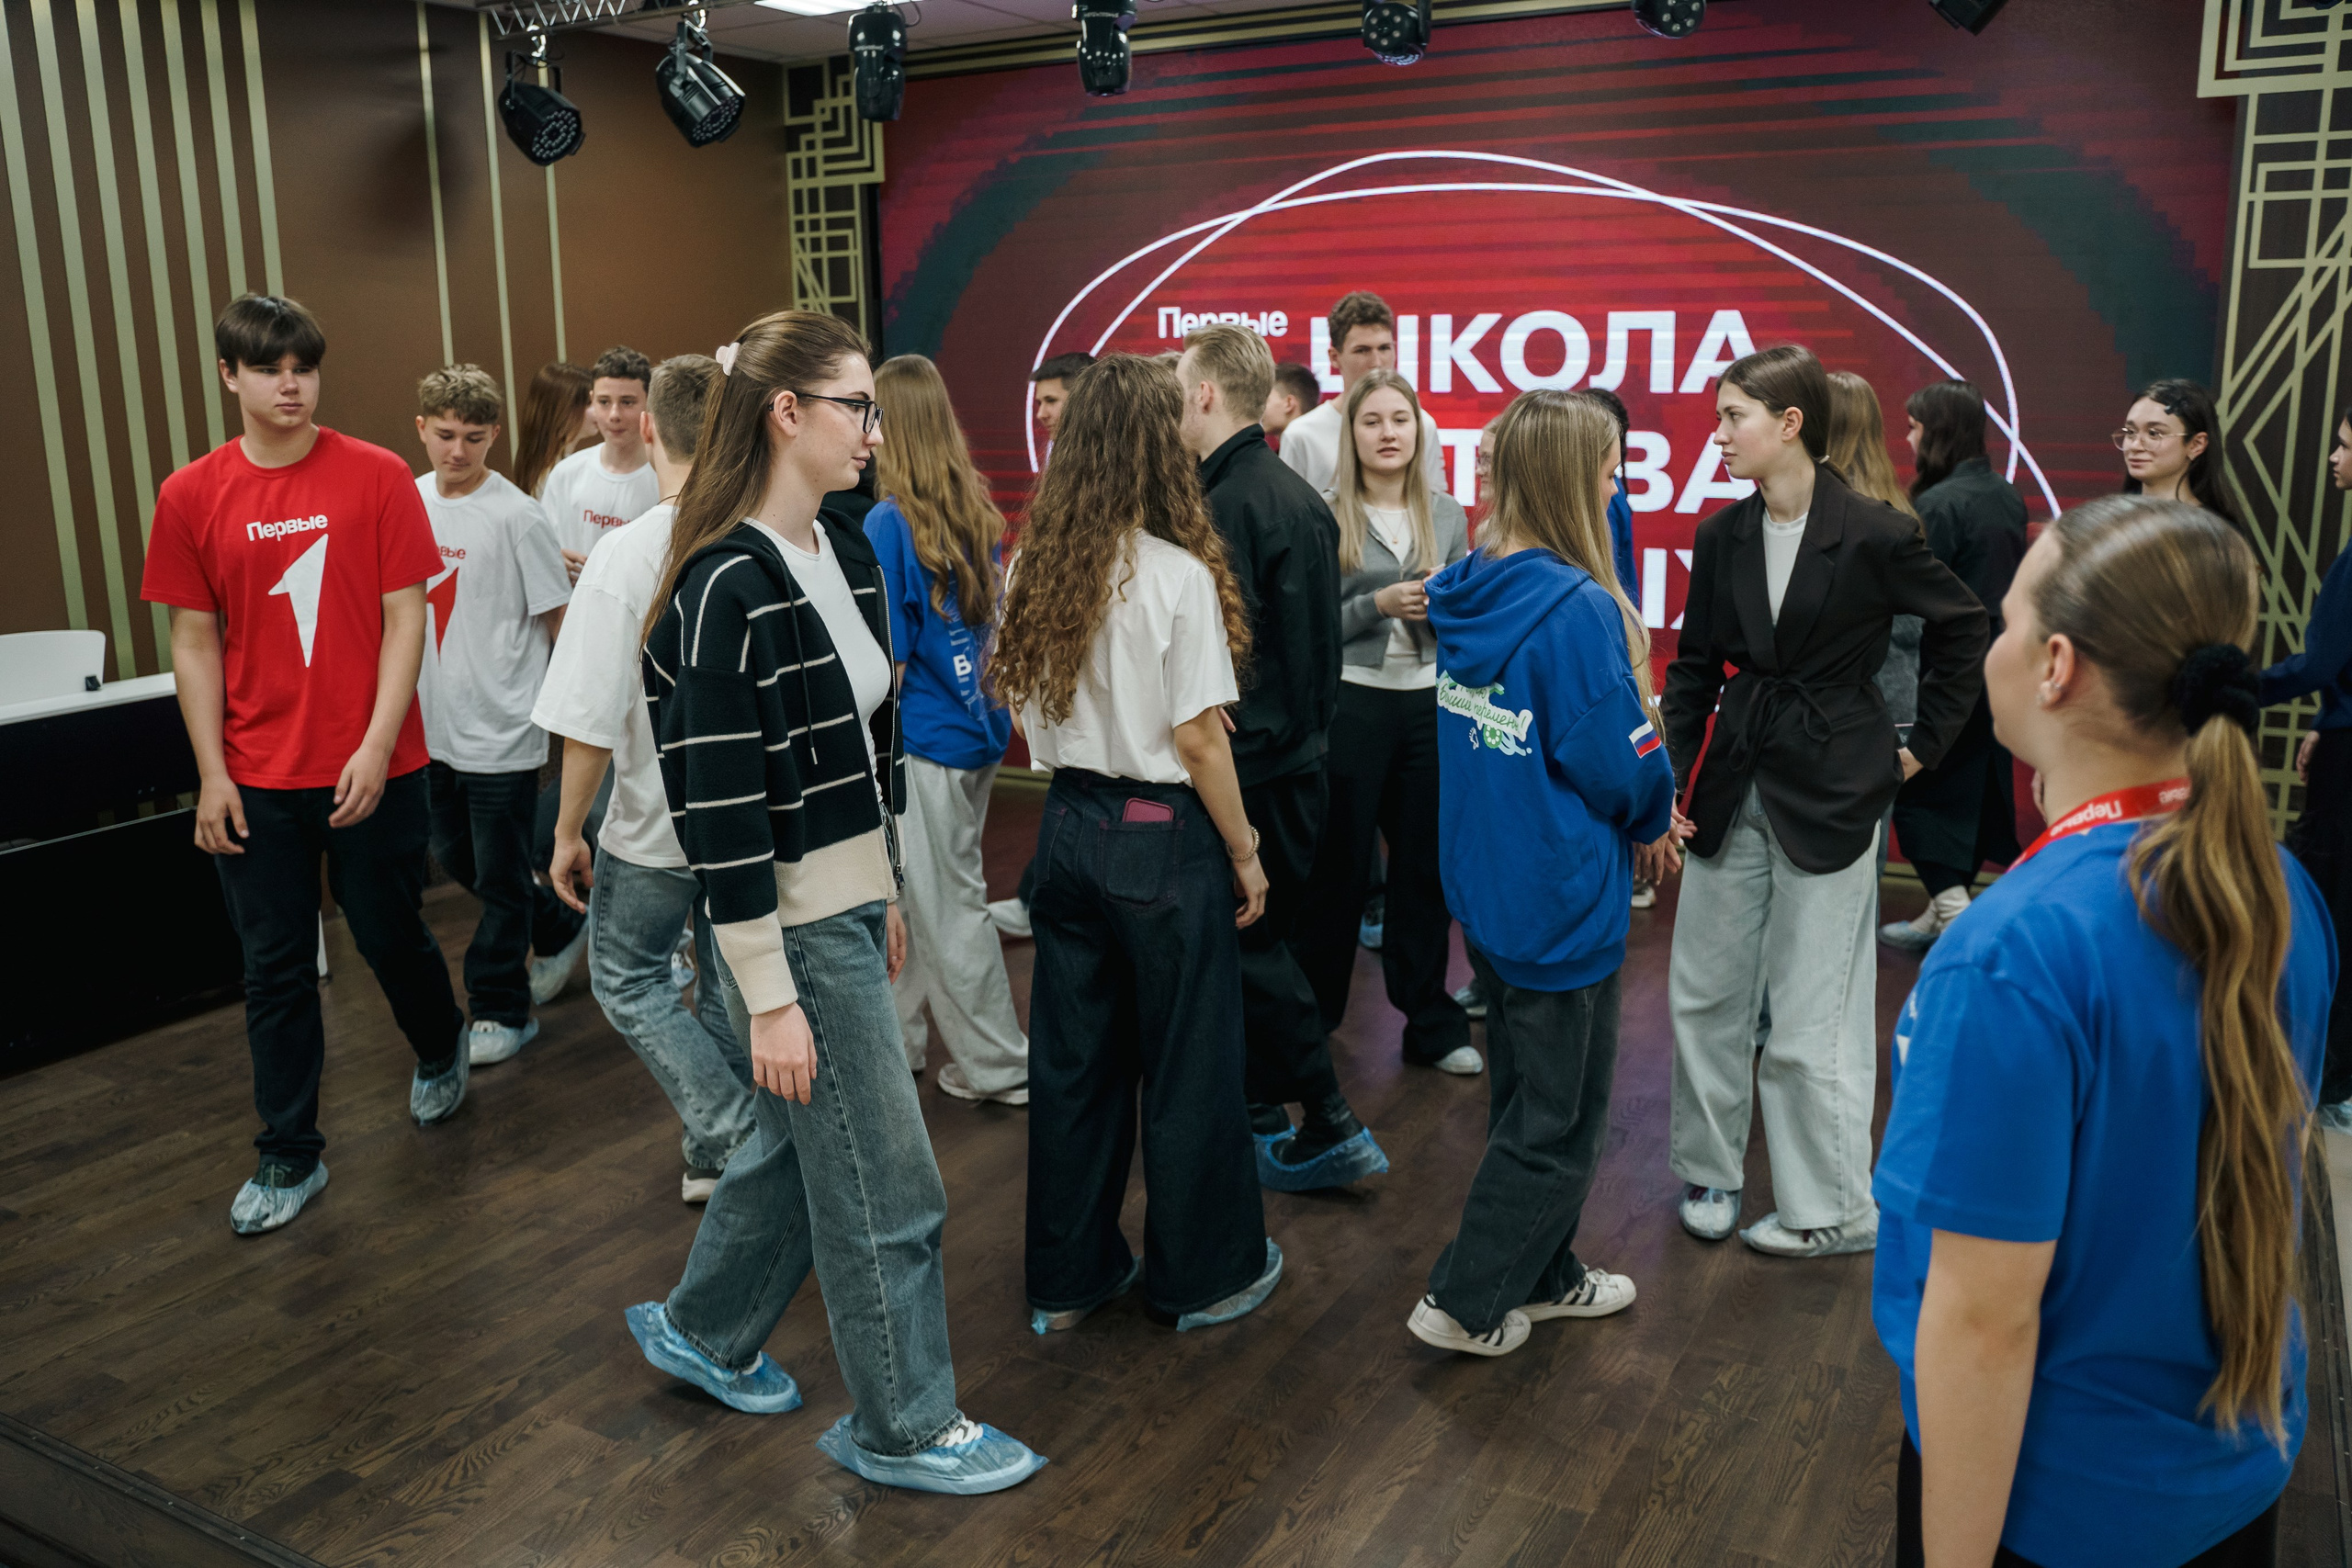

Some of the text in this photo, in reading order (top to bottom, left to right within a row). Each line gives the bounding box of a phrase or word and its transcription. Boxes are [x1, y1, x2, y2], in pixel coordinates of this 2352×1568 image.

[1158, 306, 1289, 339] Первые
[246, 513, 328, 542] Первые
[2050, 800, 2123, 837] Первые
